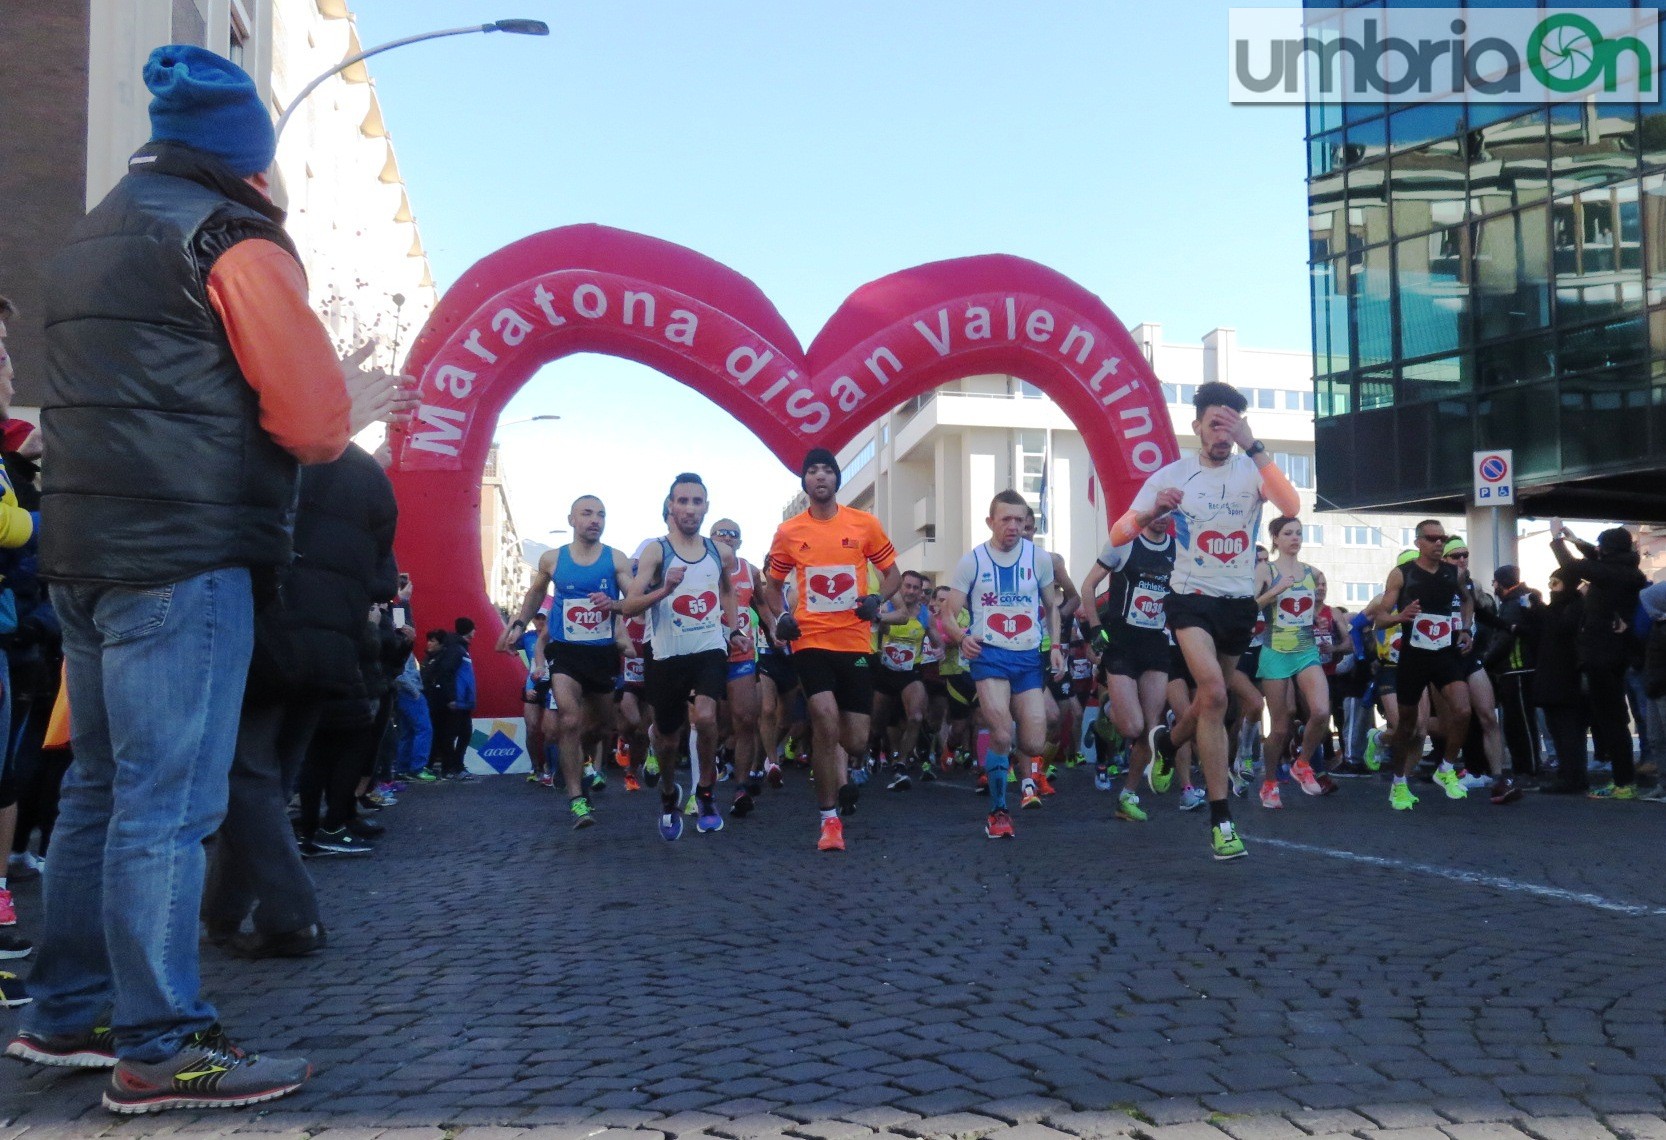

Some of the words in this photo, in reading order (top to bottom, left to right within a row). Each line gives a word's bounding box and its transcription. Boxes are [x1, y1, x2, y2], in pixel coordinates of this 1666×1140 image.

[410, 282, 699, 458] Maratona
[725, 346, 799, 403] di
[785, 346, 904, 433] San
[913, 297, 1163, 474] Valentino
[1206, 537, 1242, 555] 1006
[826, 579, 836, 594] 2
[688, 598, 707, 614] 55
[1293, 601, 1301, 612] 5
[1002, 619, 1017, 633] 18
[1428, 625, 1441, 636] 19
[483, 745, 516, 758] acea
